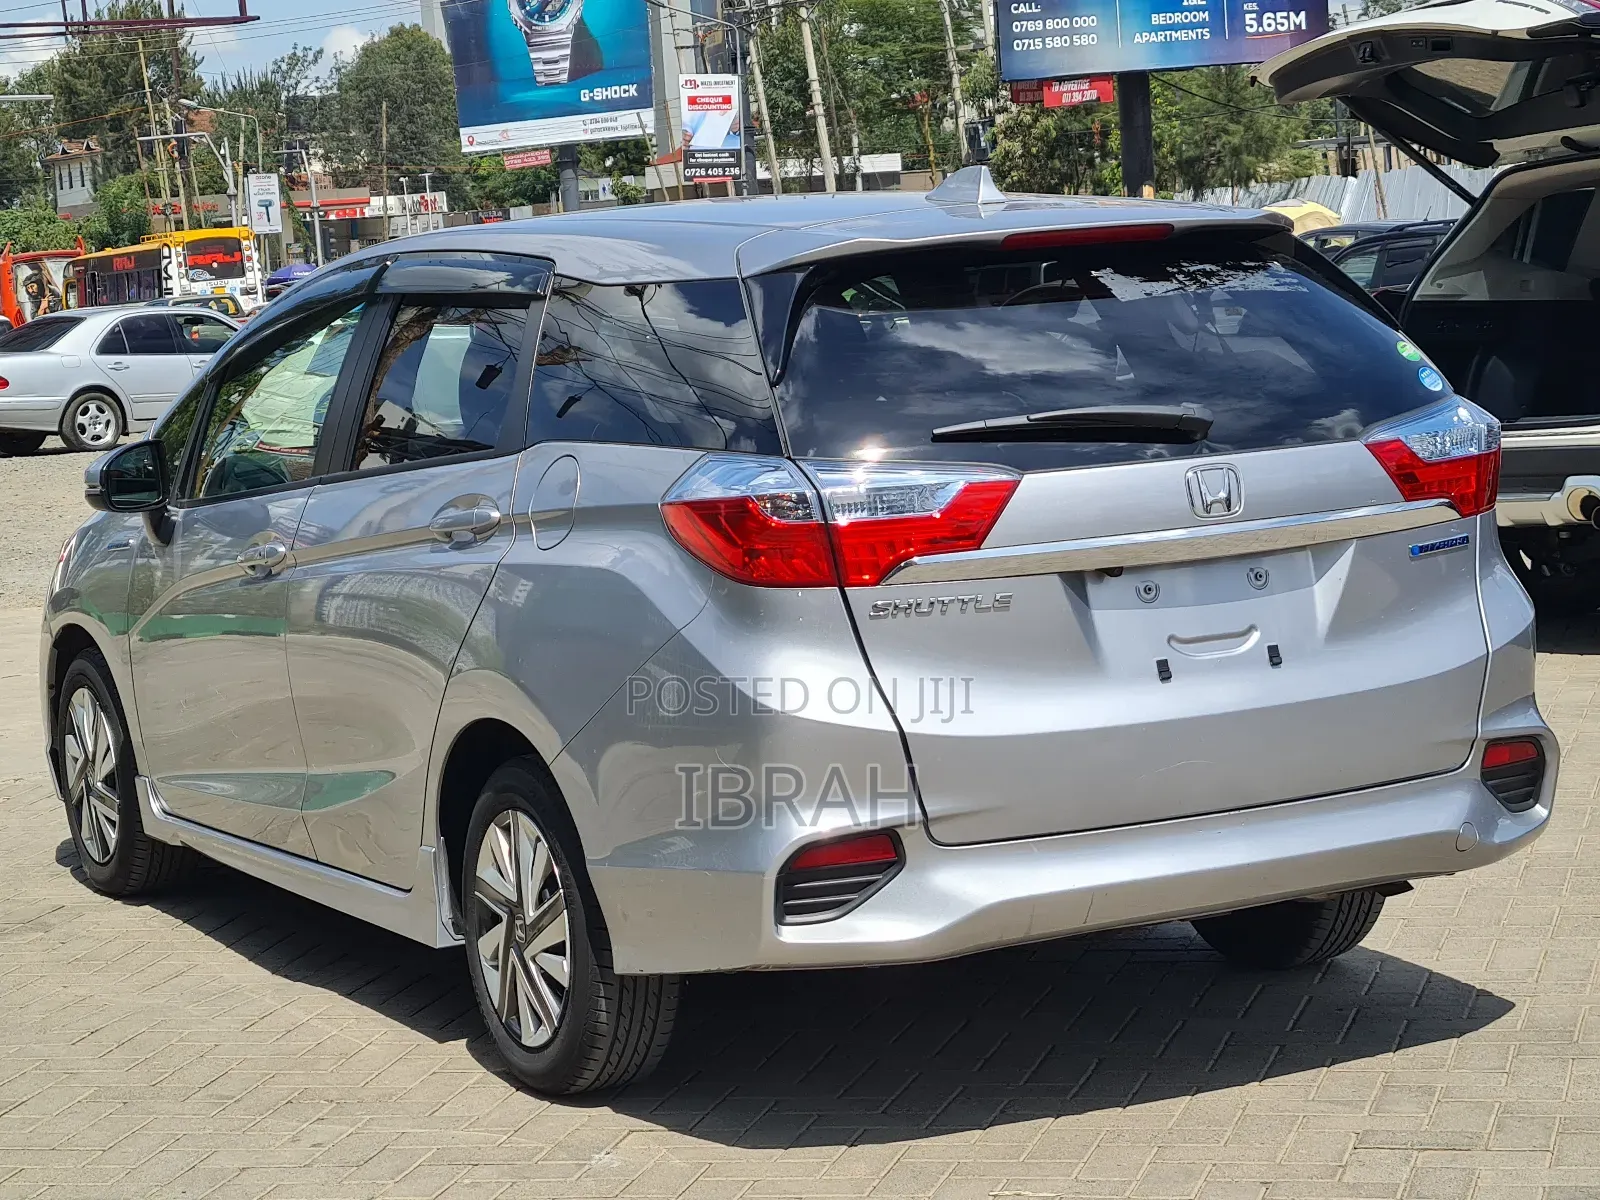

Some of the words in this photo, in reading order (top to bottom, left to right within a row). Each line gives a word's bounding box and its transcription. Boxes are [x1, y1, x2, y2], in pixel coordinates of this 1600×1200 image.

[1010, 3, 1041, 13] CALL:
[1243, 3, 1259, 11] KES.
[1012, 20, 1043, 32] 0769
[1045, 18, 1070, 30] 800
[1072, 16, 1097, 28] 000
[1151, 11, 1209, 25] BEDROOM
[1244, 11, 1307, 33] 5.65M
[1013, 38, 1043, 51] 0715
[1045, 36, 1070, 49] 580
[1072, 34, 1097, 46] 580
[1133, 28, 1210, 44] APARTMENTS
[580, 84, 638, 101] G-SHOCK
[1060, 79, 1090, 91] ADVERTISE
[684, 168, 706, 177] 0726
[707, 168, 723, 176] 405
[725, 167, 740, 175] 236
[869, 592, 1013, 620] SHUTTLE
